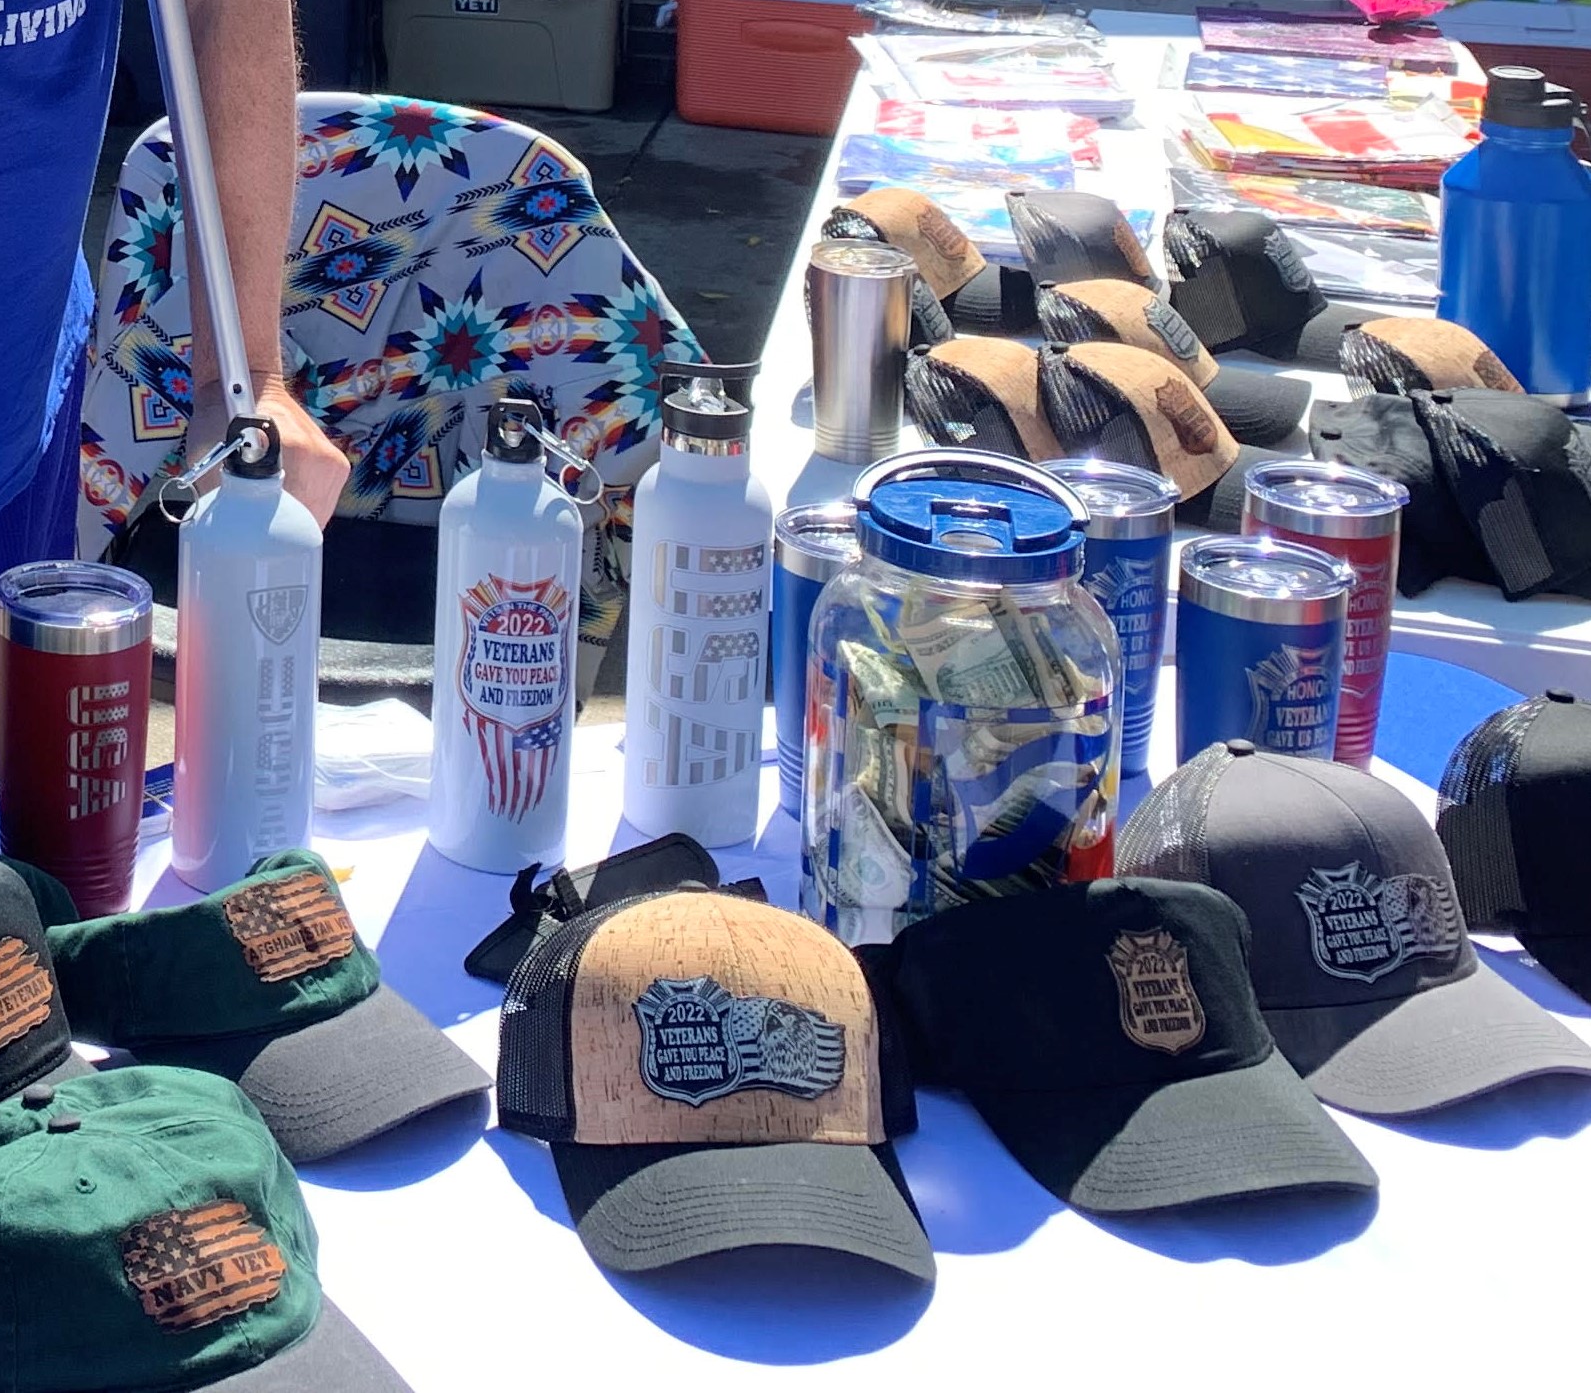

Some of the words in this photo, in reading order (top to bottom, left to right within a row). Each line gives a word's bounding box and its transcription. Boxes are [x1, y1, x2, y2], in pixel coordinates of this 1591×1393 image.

[497, 613, 545, 636] 2022
[483, 639, 555, 664] VETERANS
[475, 662, 503, 684] GAVE
[505, 666, 529, 686] YOU
[530, 665, 559, 685] PEACE
[480, 686, 504, 706] AND
[505, 687, 554, 707] FREEDOM
[66, 681, 130, 820] USA
[1329, 891, 1365, 910] 2022
[1324, 910, 1378, 931] VETERANS
[249, 920, 334, 962] AFGHANISTAN
[1326, 932, 1347, 948] GAVE
[1347, 930, 1364, 946] YOU
[1365, 927, 1389, 943] PEACE
[1335, 947, 1353, 964] AND
[1353, 944, 1390, 962] FREEDOM
[1136, 955, 1166, 975] 2022
[1133, 978, 1181, 998] VETERANS
[668, 1002, 705, 1023] 2022
[659, 1026, 718, 1046] VETERANS
[657, 1048, 678, 1065] GAVE
[680, 1048, 697, 1063] YOU
[698, 1046, 726, 1062] PEACE
[664, 1065, 682, 1082] AND
[684, 1064, 724, 1081] FREEDOM
[153, 1262, 225, 1307] NAVY
[231, 1250, 272, 1275] VET
